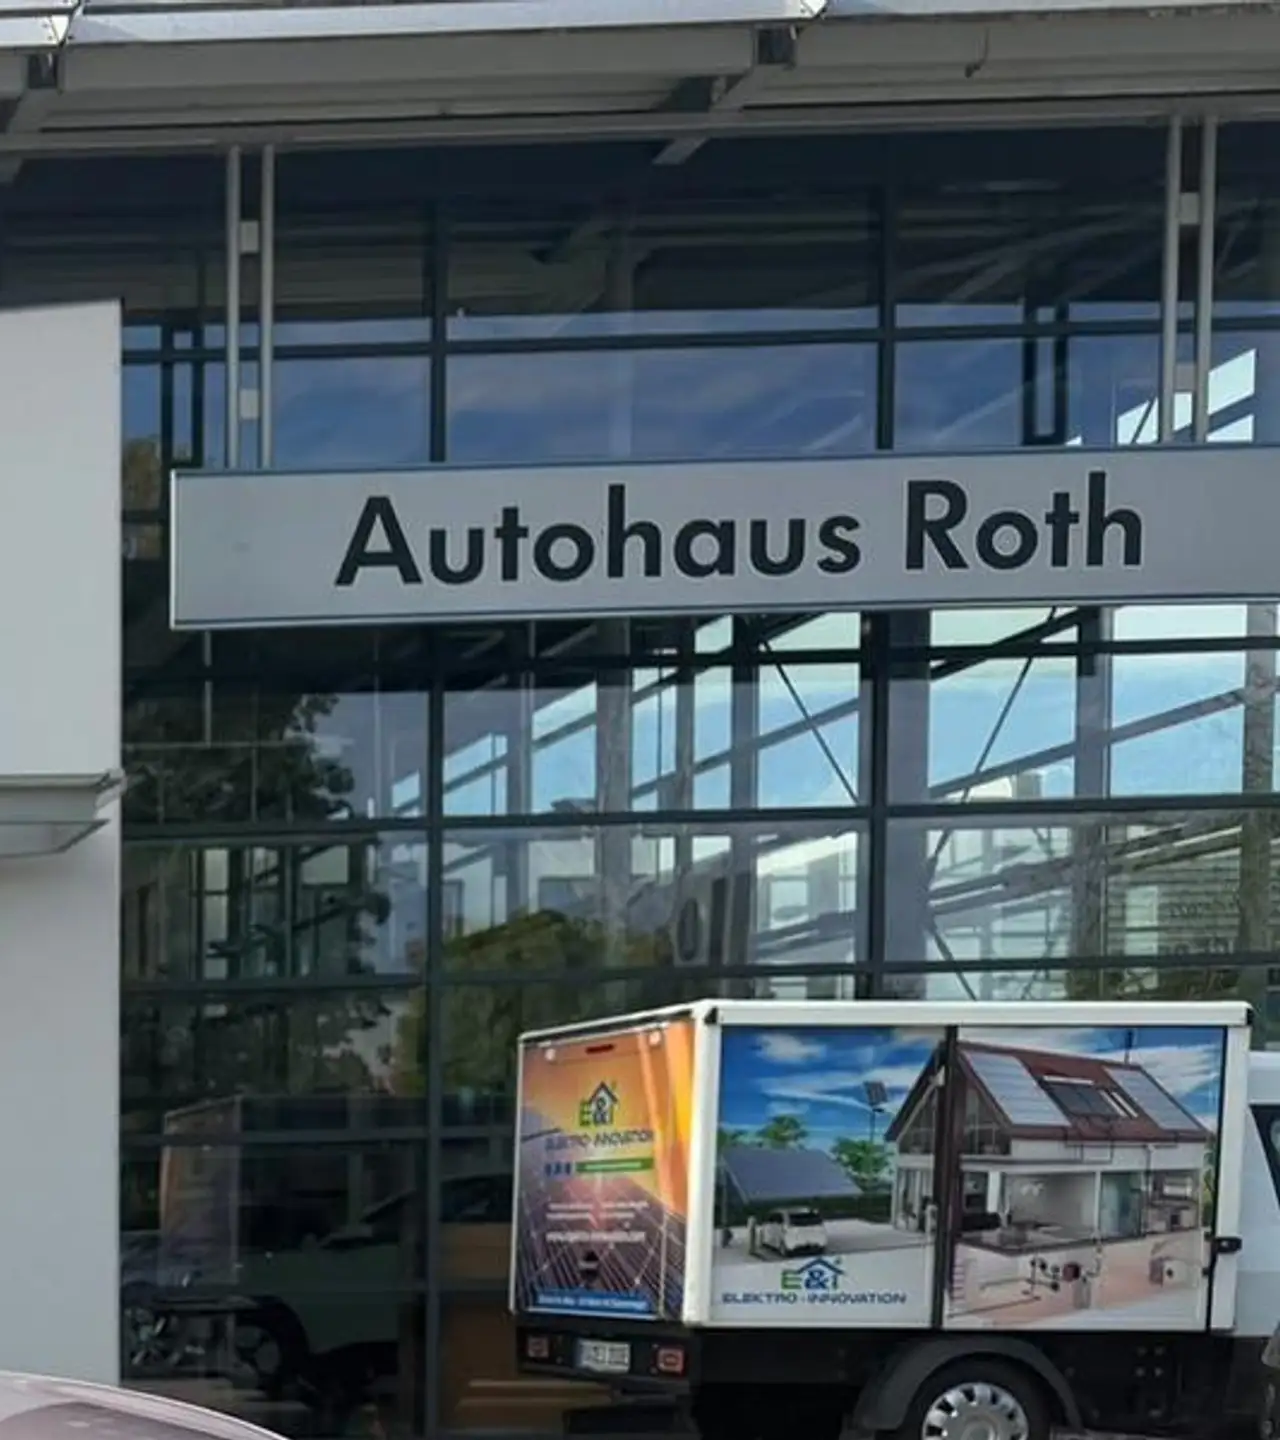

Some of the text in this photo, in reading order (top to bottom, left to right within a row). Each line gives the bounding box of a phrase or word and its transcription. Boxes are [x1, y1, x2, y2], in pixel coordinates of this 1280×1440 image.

[334, 471, 1146, 588] Autohaus Roth
[780, 1268, 840, 1290] E&I
[721, 1292, 798, 1305] ELEKTRO
[807, 1291, 907, 1305] INNOVATION
